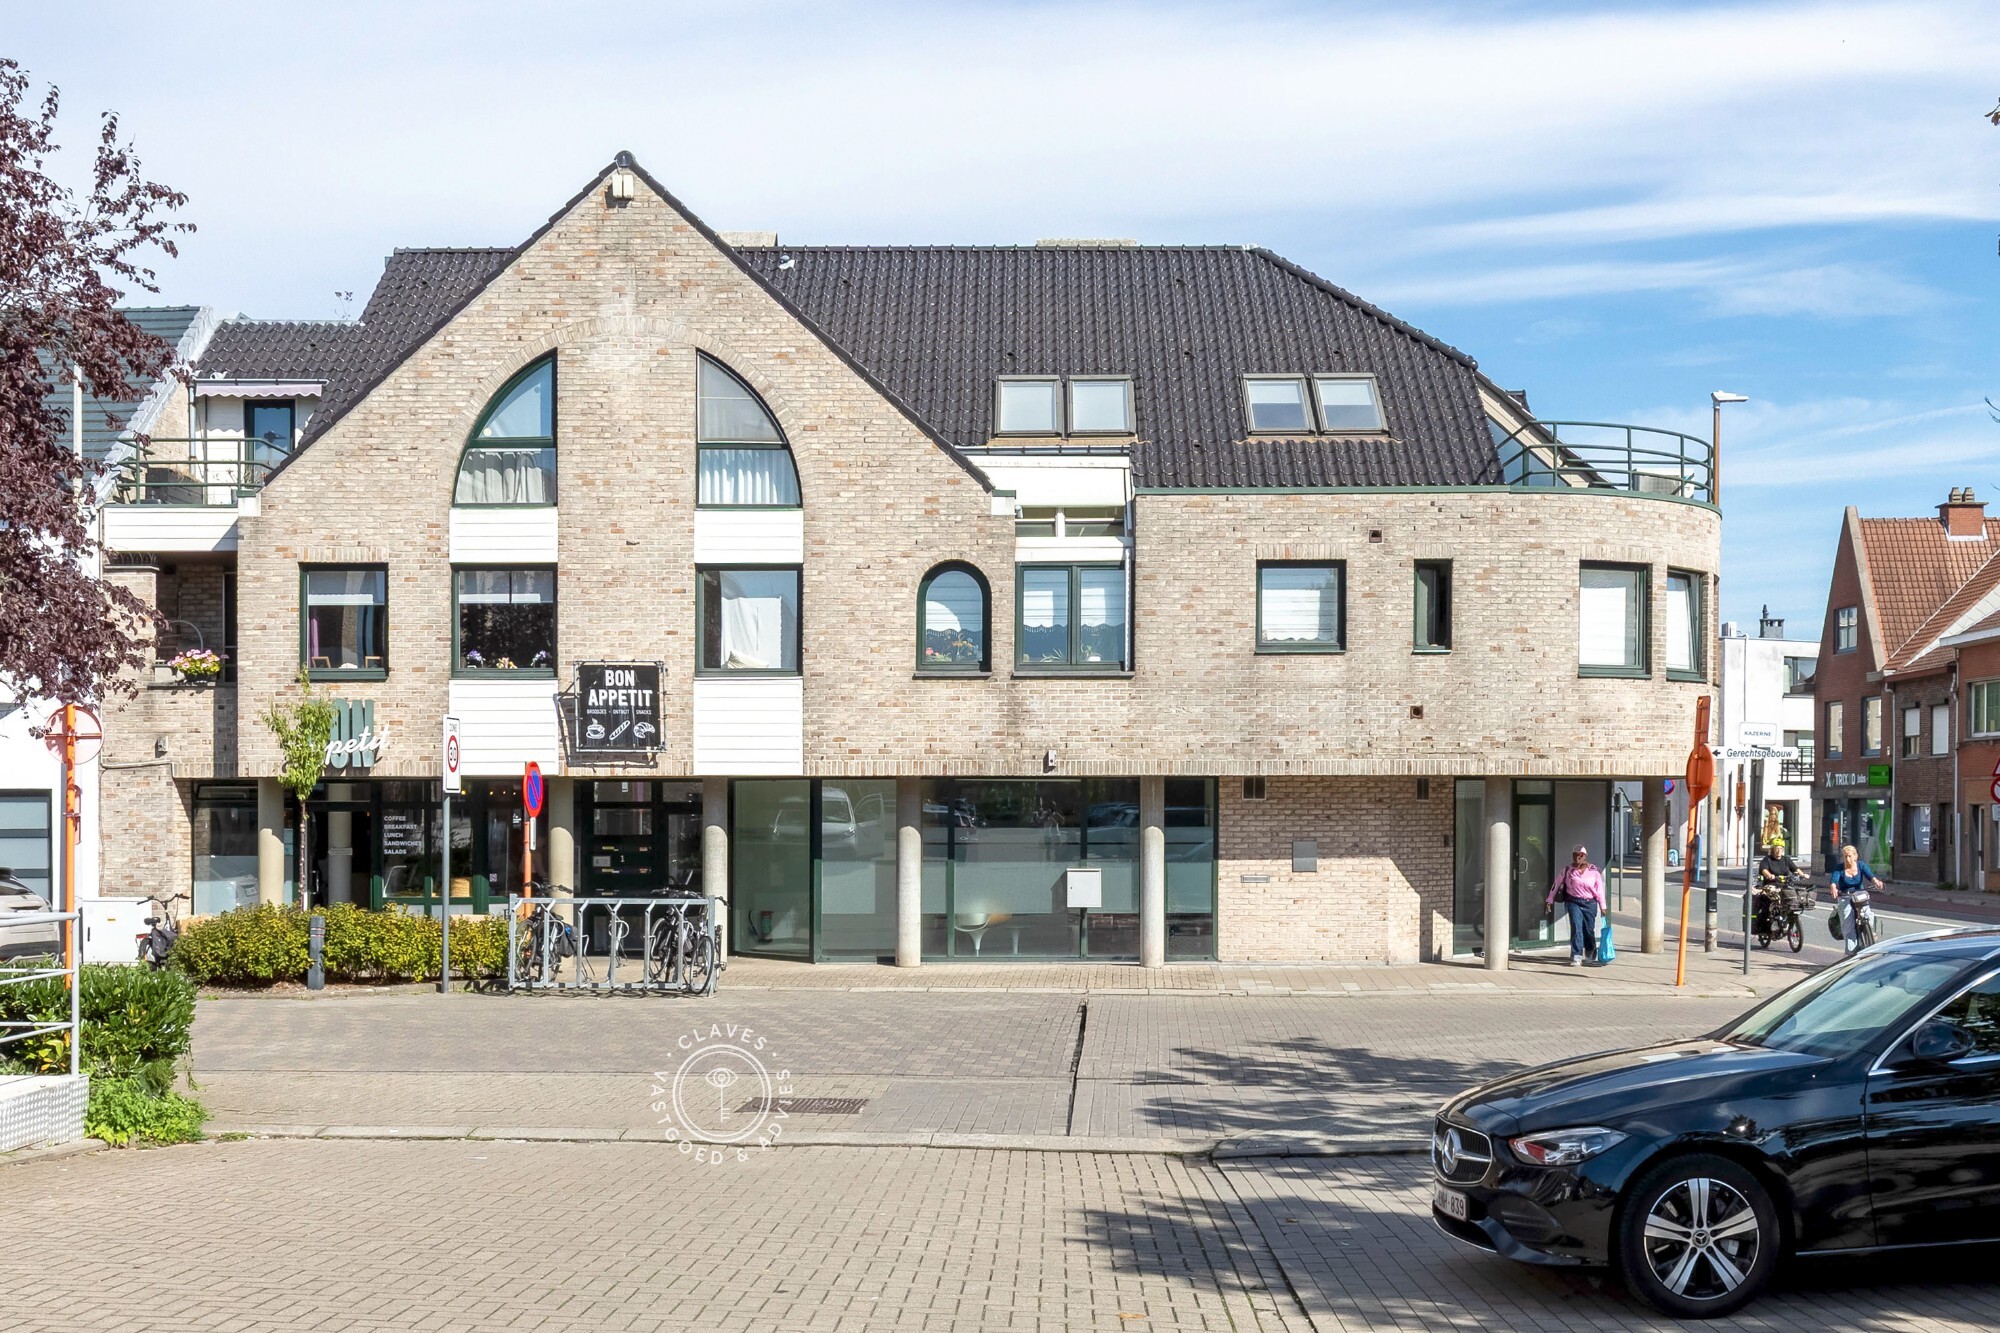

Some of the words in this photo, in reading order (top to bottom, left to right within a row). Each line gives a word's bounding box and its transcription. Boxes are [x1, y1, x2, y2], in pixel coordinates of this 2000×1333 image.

[605, 669, 635, 687] BON
[588, 688, 653, 707] APPETIT
[1726, 748, 1793, 760] Gerechtsgebouw
